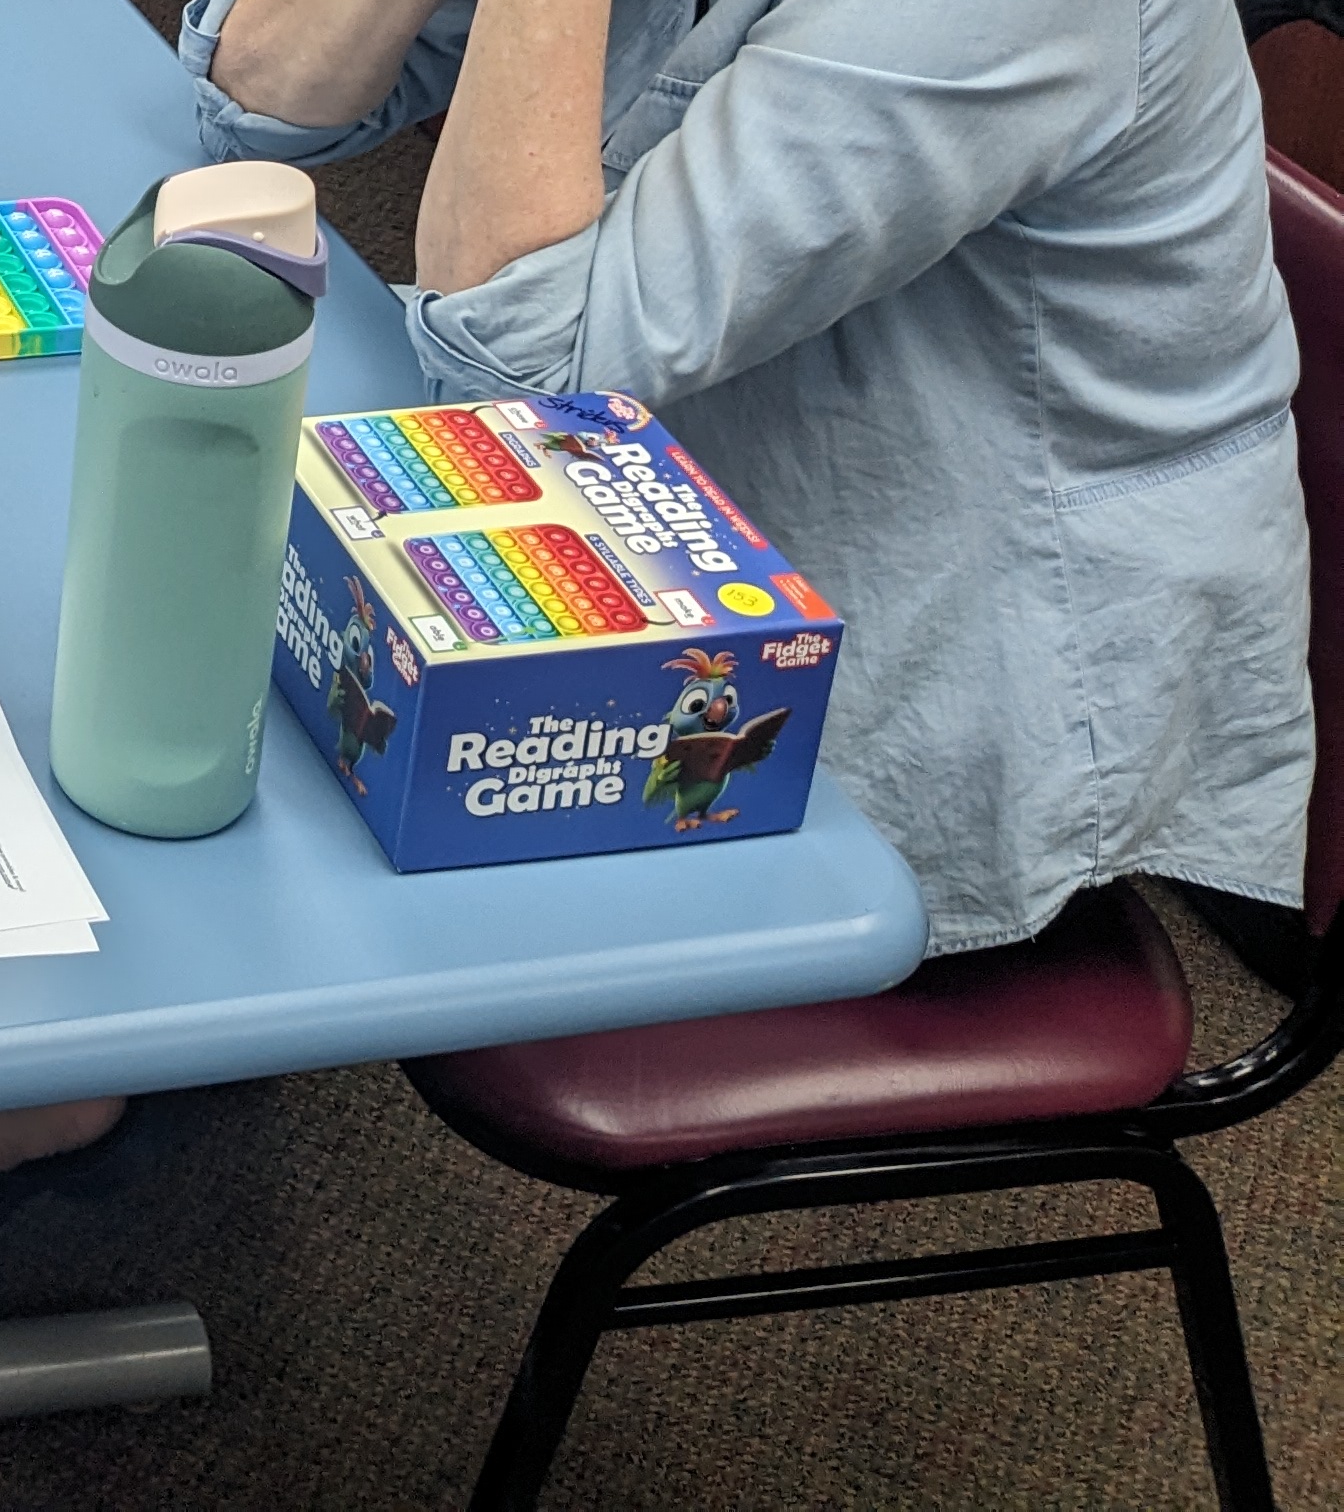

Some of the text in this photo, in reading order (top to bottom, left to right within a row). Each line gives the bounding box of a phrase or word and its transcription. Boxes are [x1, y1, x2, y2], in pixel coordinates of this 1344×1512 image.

[153, 354, 240, 385] owala
[502, 433, 537, 467] DIGRAPHS
[564, 461, 662, 556] Game
[601, 442, 738, 573] Reading
[611, 480, 679, 549] Digraphs
[671, 451, 761, 544] LEARN TO READ IN WEEKS!
[672, 483, 703, 512] The
[288, 543, 306, 581] The
[594, 541, 632, 579] SYLLABLE
[625, 577, 652, 605] TYPES
[281, 560, 344, 671] ading
[726, 588, 758, 608] 153
[276, 605, 322, 690] ame
[386, 626, 419, 683] Fidget
[761, 638, 832, 660] Fidget
[796, 633, 822, 645] The
[775, 655, 819, 668] Game
[245, 696, 263, 775] owala
[446, 719, 672, 773] Reading
[529, 714, 574, 736] The
[507, 757, 623, 786] Digraphs
[465, 775, 625, 817] Game
